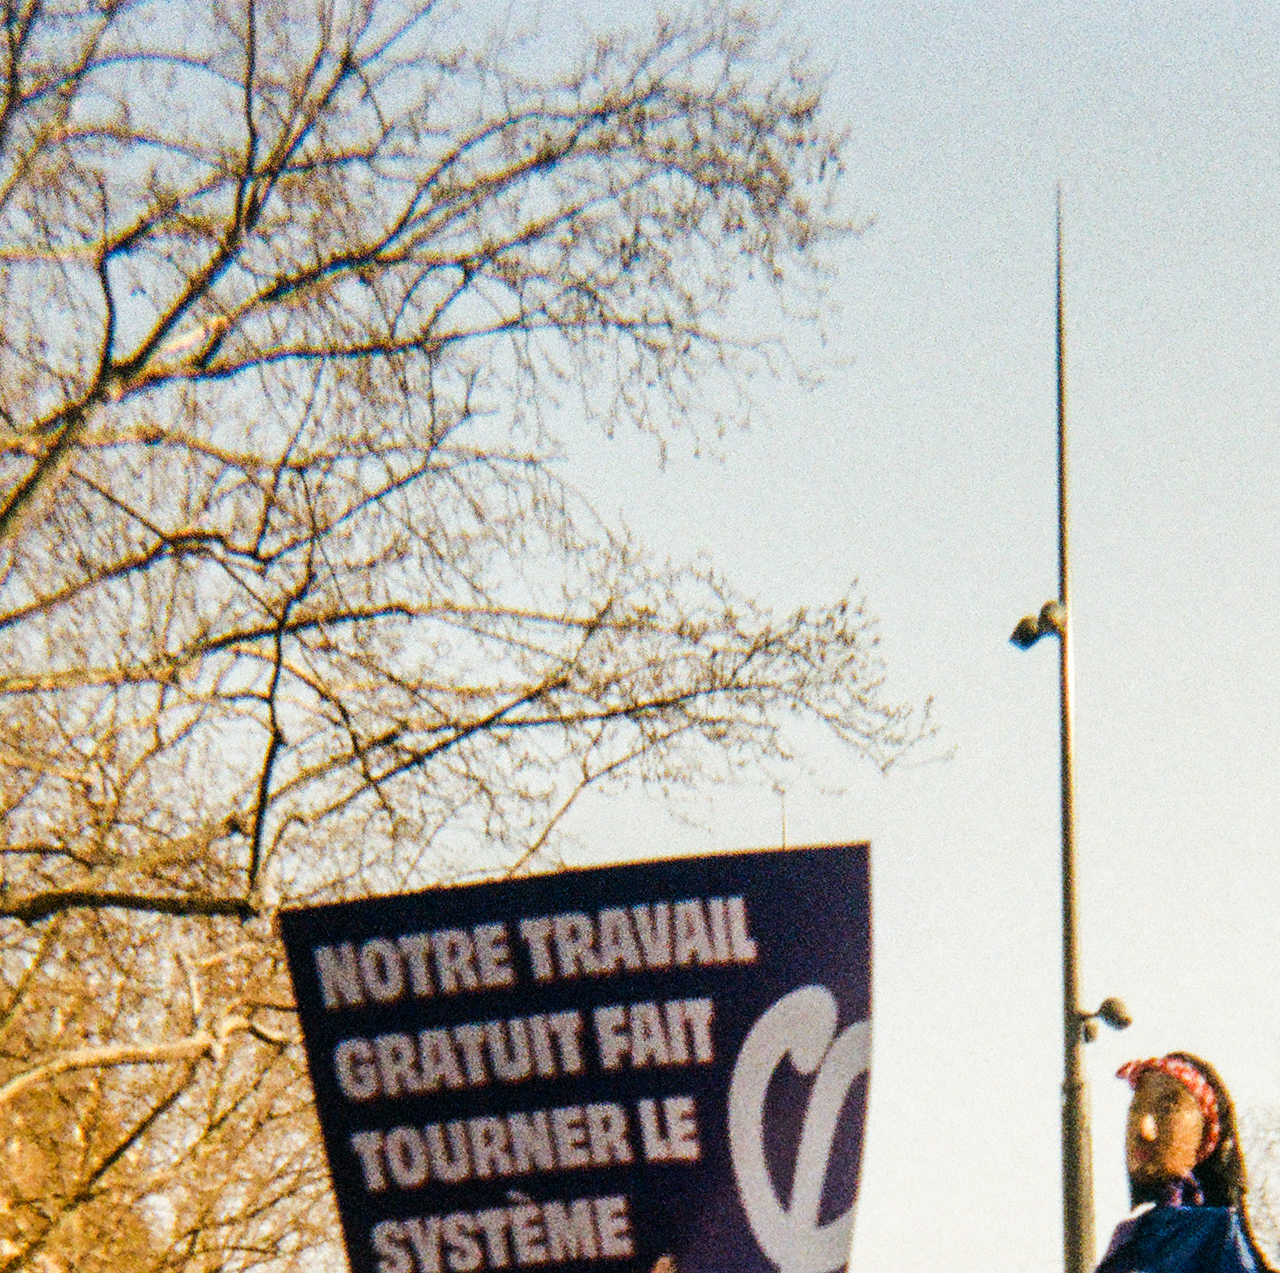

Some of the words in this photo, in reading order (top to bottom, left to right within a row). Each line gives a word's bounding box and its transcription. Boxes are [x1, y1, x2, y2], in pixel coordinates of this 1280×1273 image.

[316, 924, 511, 1006] NOTRE
[521, 896, 757, 979] TRAVAIL
[334, 1011, 581, 1098] GRATUIT
[594, 999, 714, 1068] FAIT
[352, 1103, 632, 1190] TOURNER
[638, 1096, 700, 1160] LE
